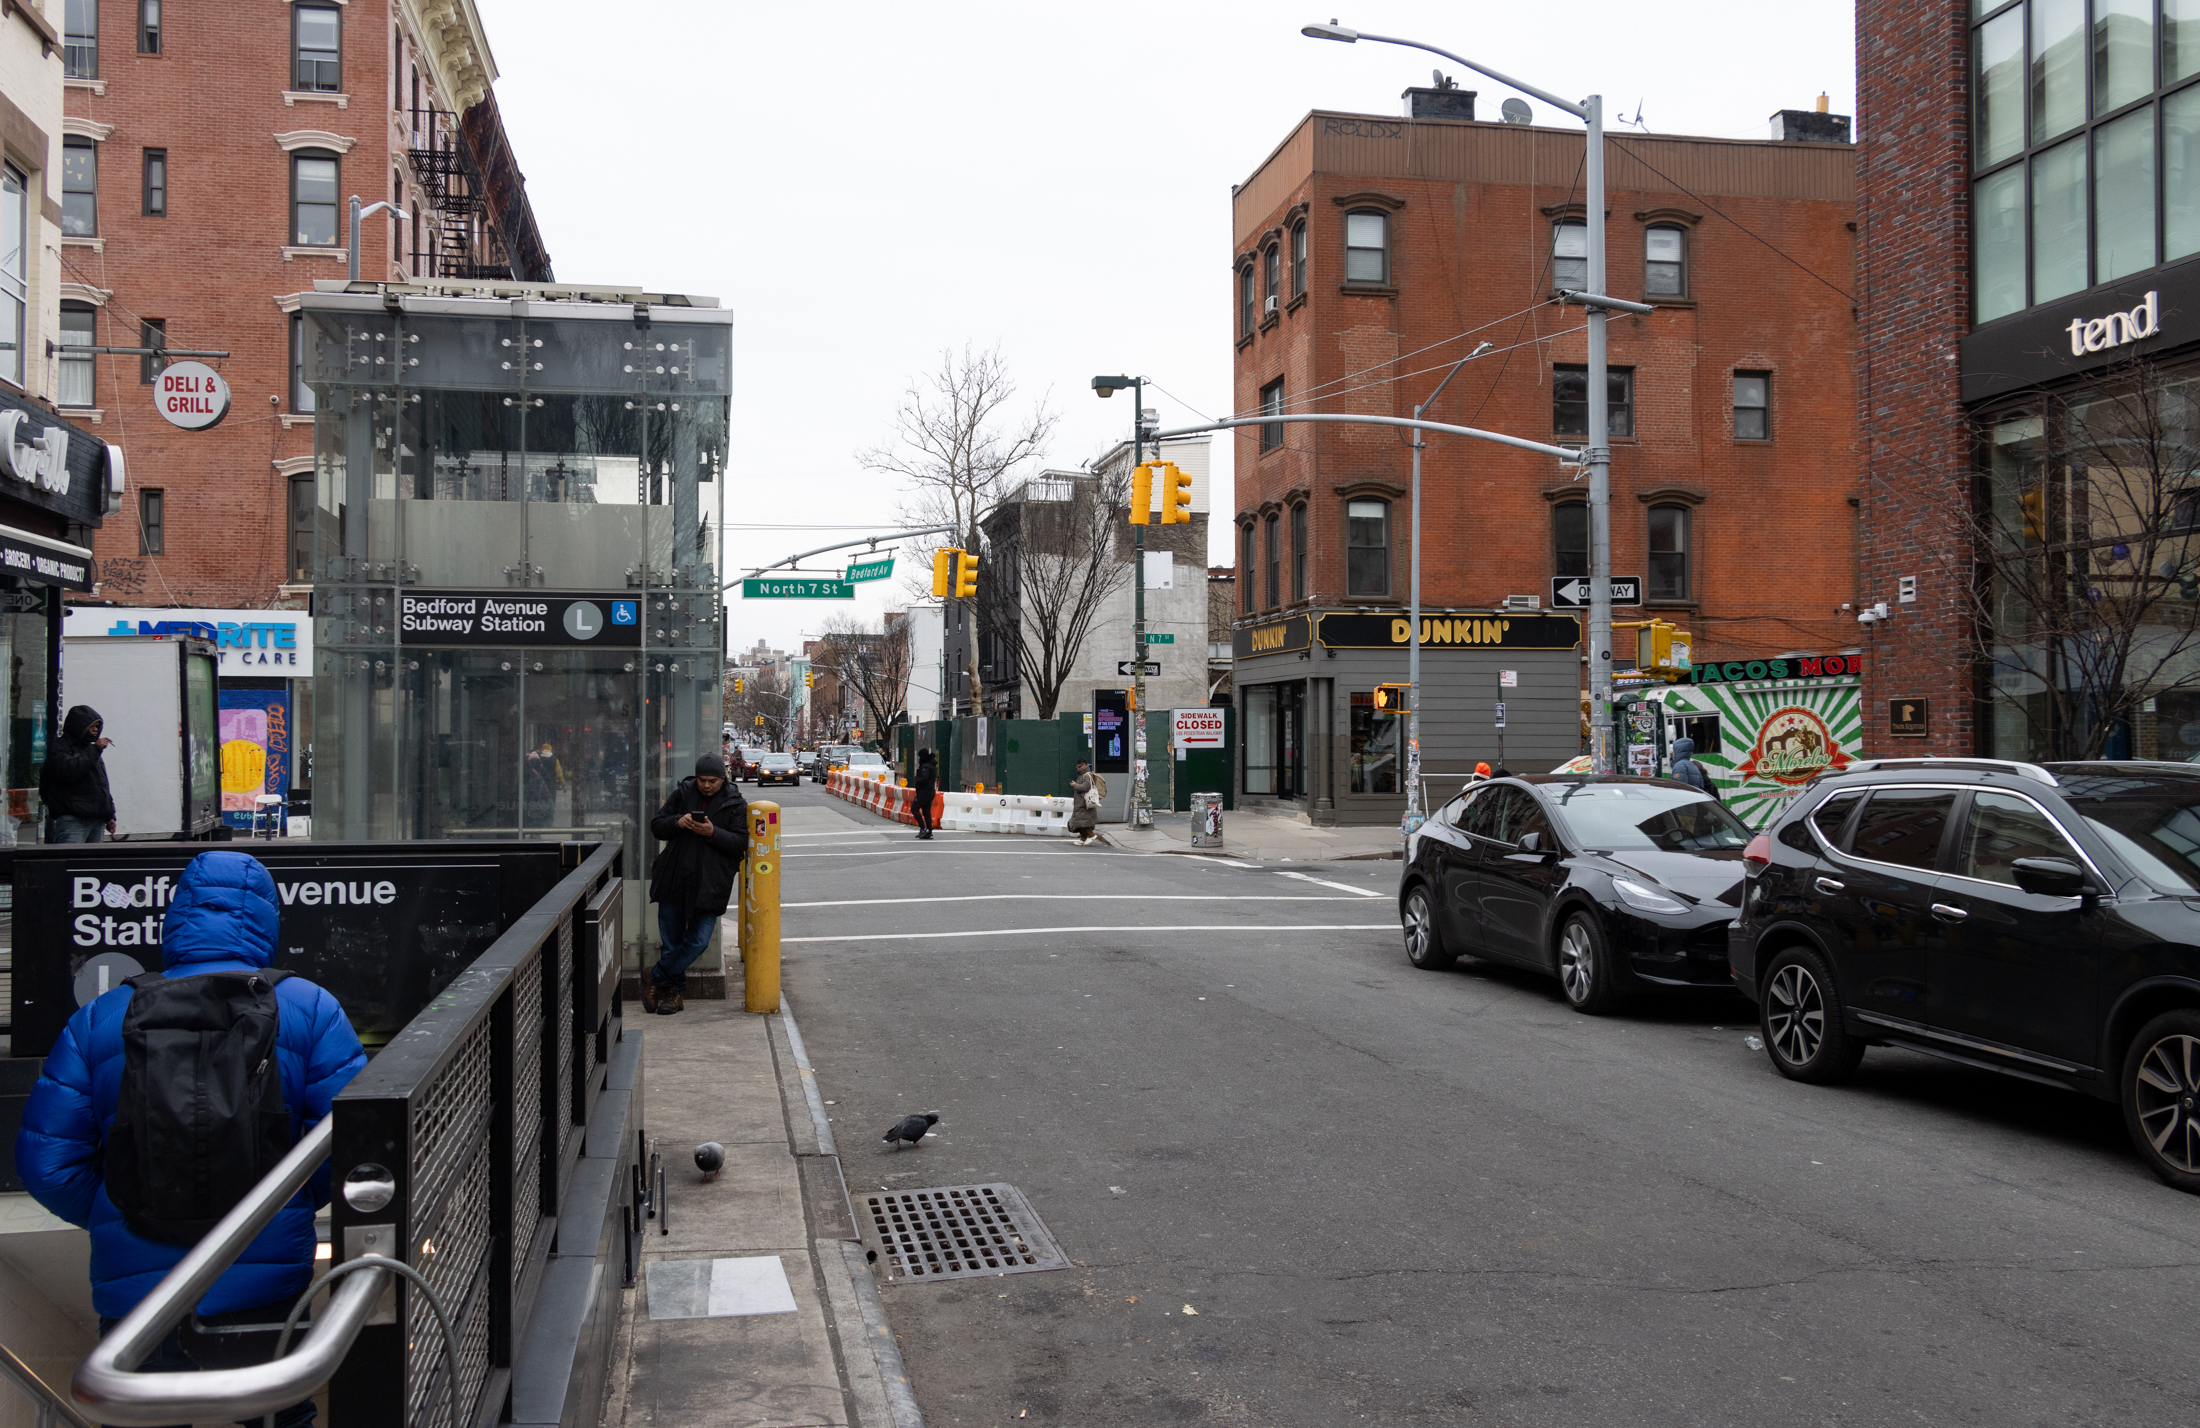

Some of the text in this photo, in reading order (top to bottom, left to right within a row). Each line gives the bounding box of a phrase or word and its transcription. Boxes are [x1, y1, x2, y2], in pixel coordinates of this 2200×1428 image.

[2065, 290, 2161, 357] tend
[164, 375, 216, 393] DELI &
[167, 396, 214, 414] GRILL
[4, 548, 31, 570] GROCERY
[850, 564, 888, 580] Bedford Av
[760, 583, 838, 594] North 7 St
[402, 598, 548, 615] Bedford Avenue
[402, 615, 545, 634] Subway Station
[576, 608, 593, 631] L
[1150, 635, 1155, 643] N
[1158, 635, 1162, 643] 7
[1252, 624, 1287, 652] DUNKIN'
[1391, 618, 1510, 644] DUNKIN'
[242, 652, 297, 665] CARE
[1691, 655, 1862, 683] TACOS MOR
[1176, 720, 1223, 730] CLOSED
[1755, 746, 1833, 779] Morelos
[1758, 789, 1788, 799] Authentic
[277, 879, 397, 906] venue
[73, 913, 164, 947] Stati
